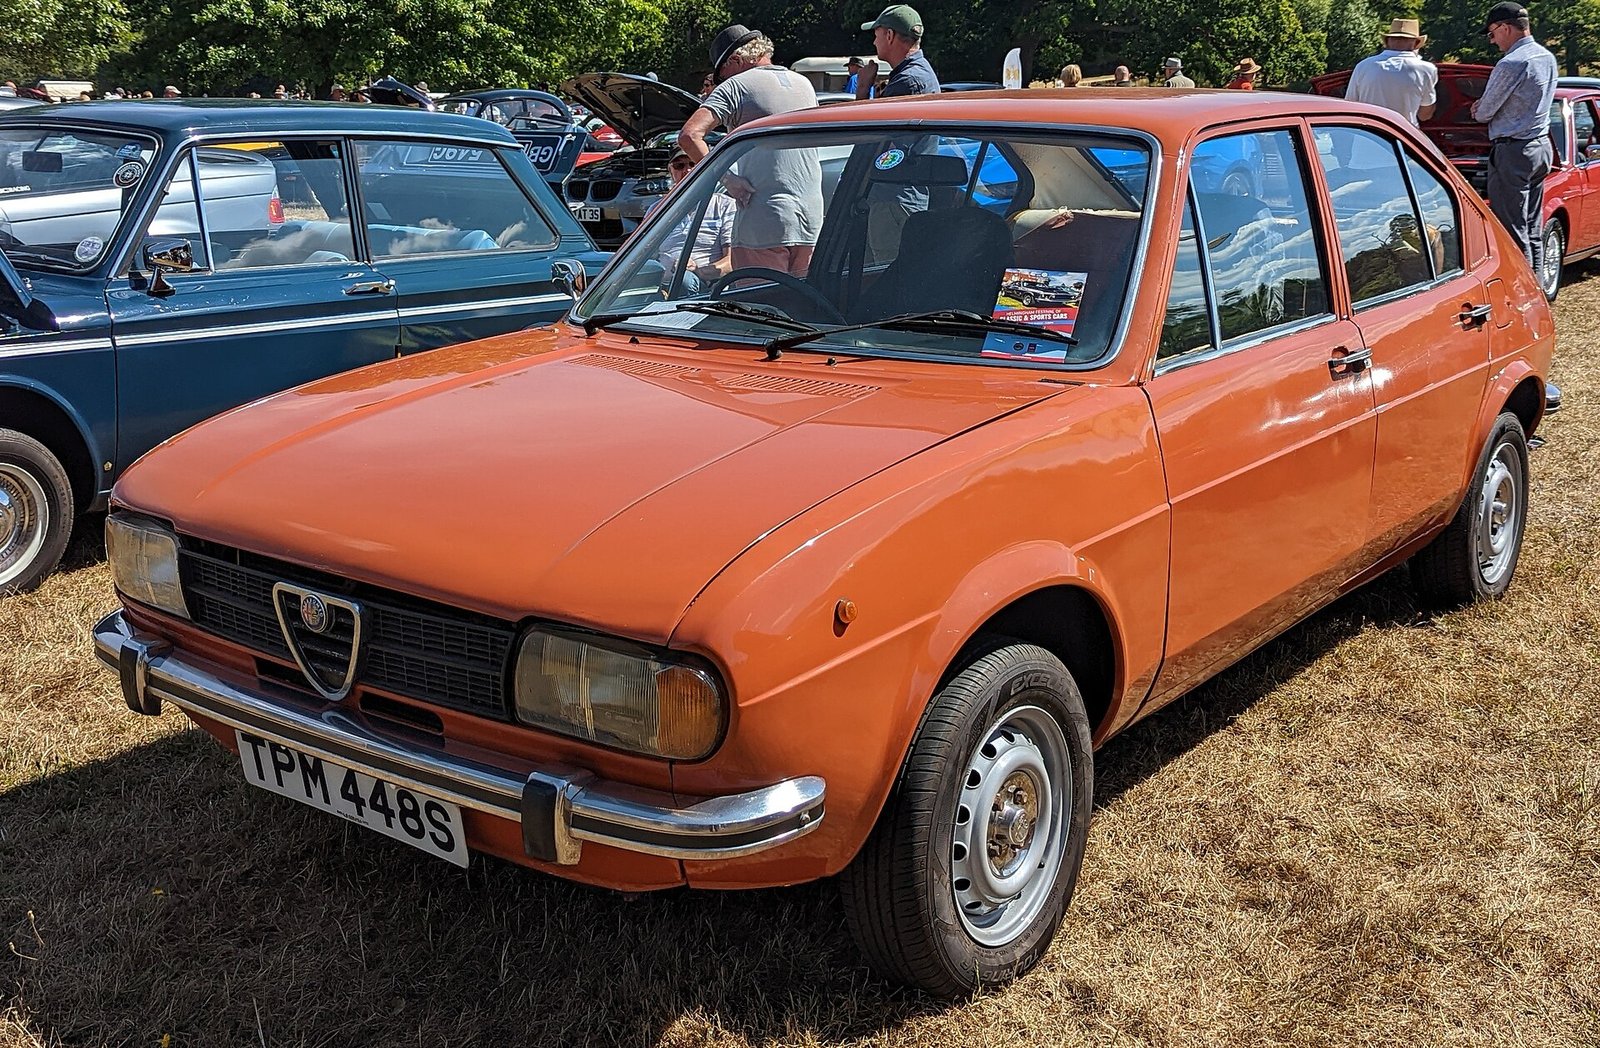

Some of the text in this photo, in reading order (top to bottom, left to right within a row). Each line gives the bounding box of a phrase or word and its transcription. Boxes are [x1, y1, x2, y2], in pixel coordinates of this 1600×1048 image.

[589, 209, 599, 220] 3S
[241, 731, 456, 853] TPM 448S
